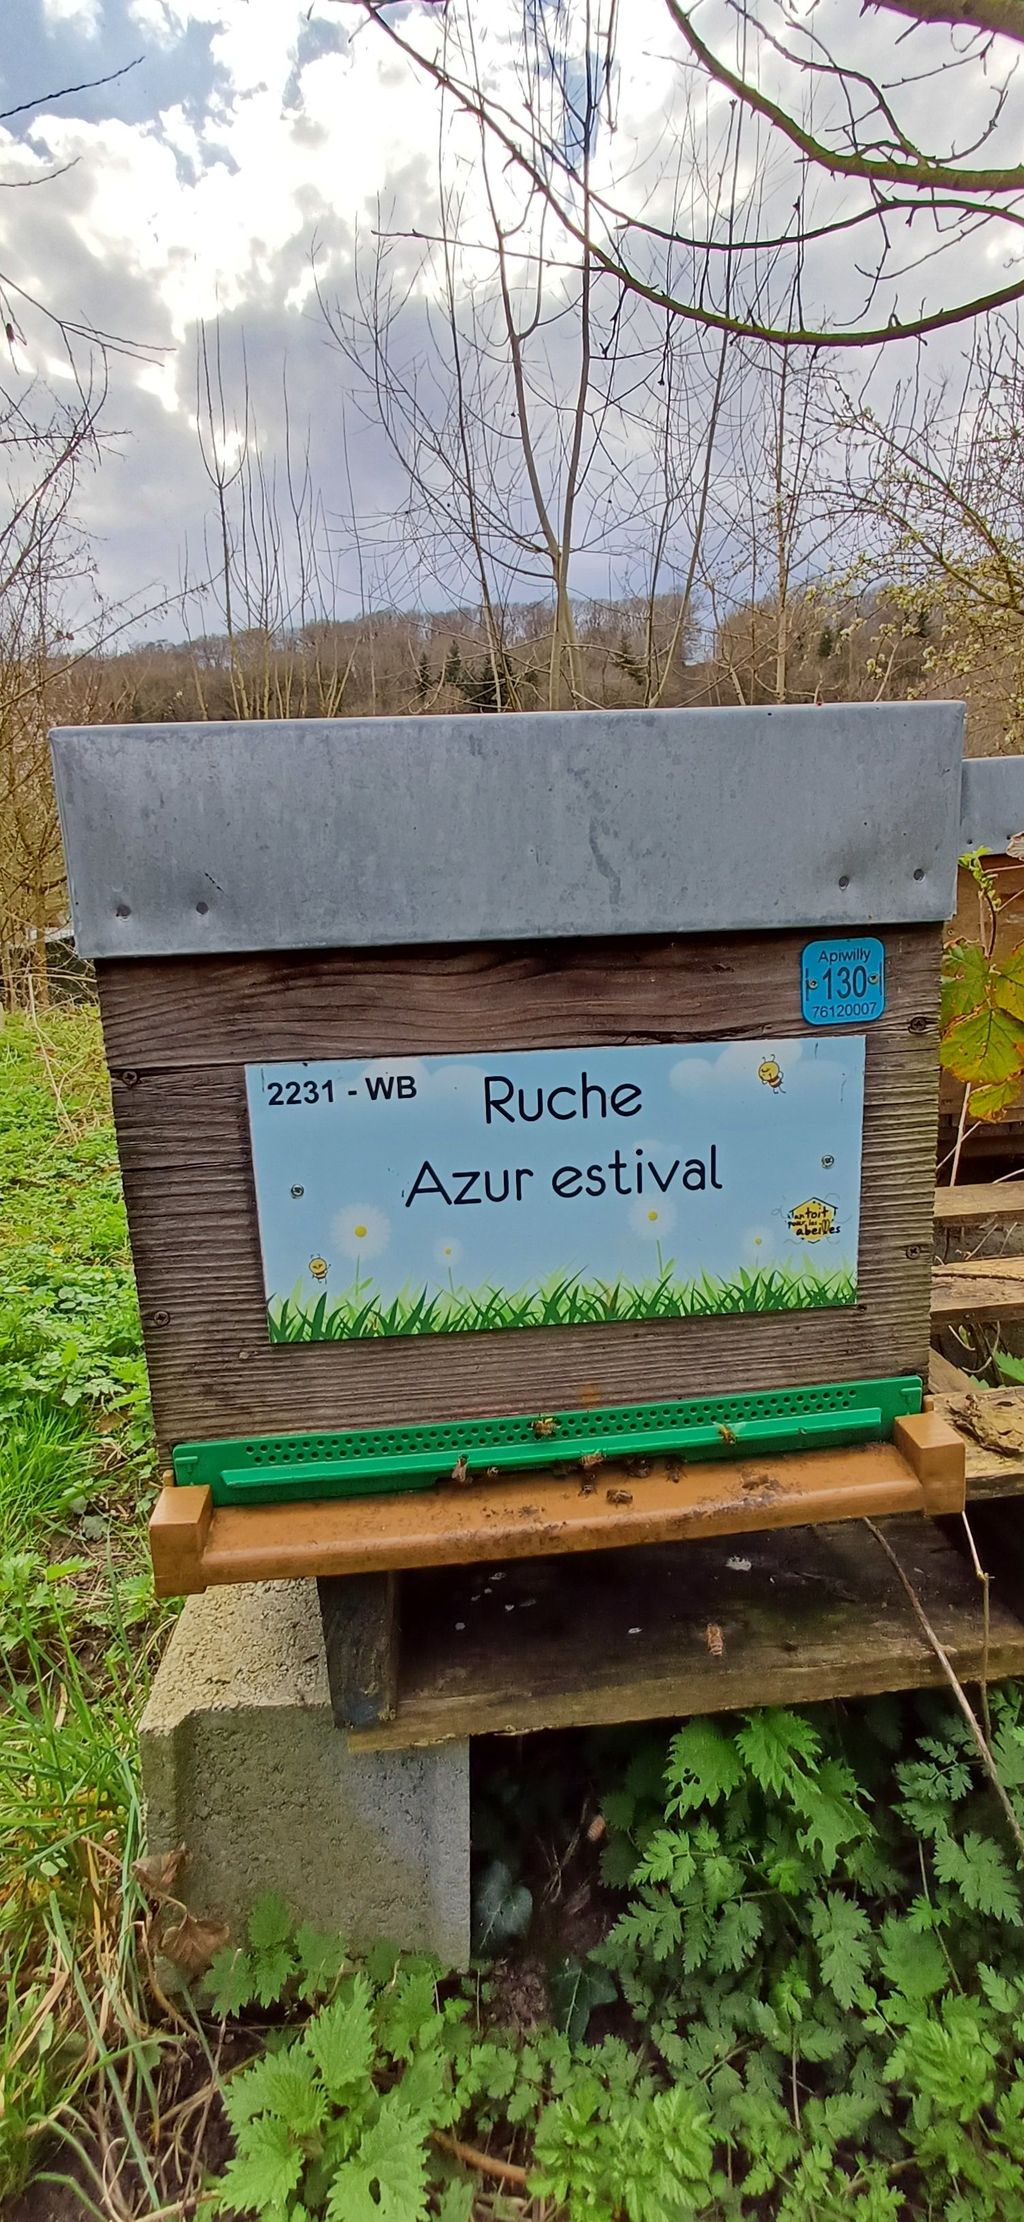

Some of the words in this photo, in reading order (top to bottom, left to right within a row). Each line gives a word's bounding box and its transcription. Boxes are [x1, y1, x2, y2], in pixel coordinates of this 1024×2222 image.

[818, 948, 871, 965] Apiwilly
[822, 965, 867, 1000] 130
[812, 1002, 877, 1018] 76120007
[267, 1079, 334, 1106] 2231
[365, 1075, 418, 1101] WB
[484, 1071, 642, 1124] Ruche
[405, 1160, 534, 1208] Azur
[551, 1144, 723, 1198] estival
[805, 1206, 829, 1219] toit
[796, 1219, 841, 1236] abeilles
